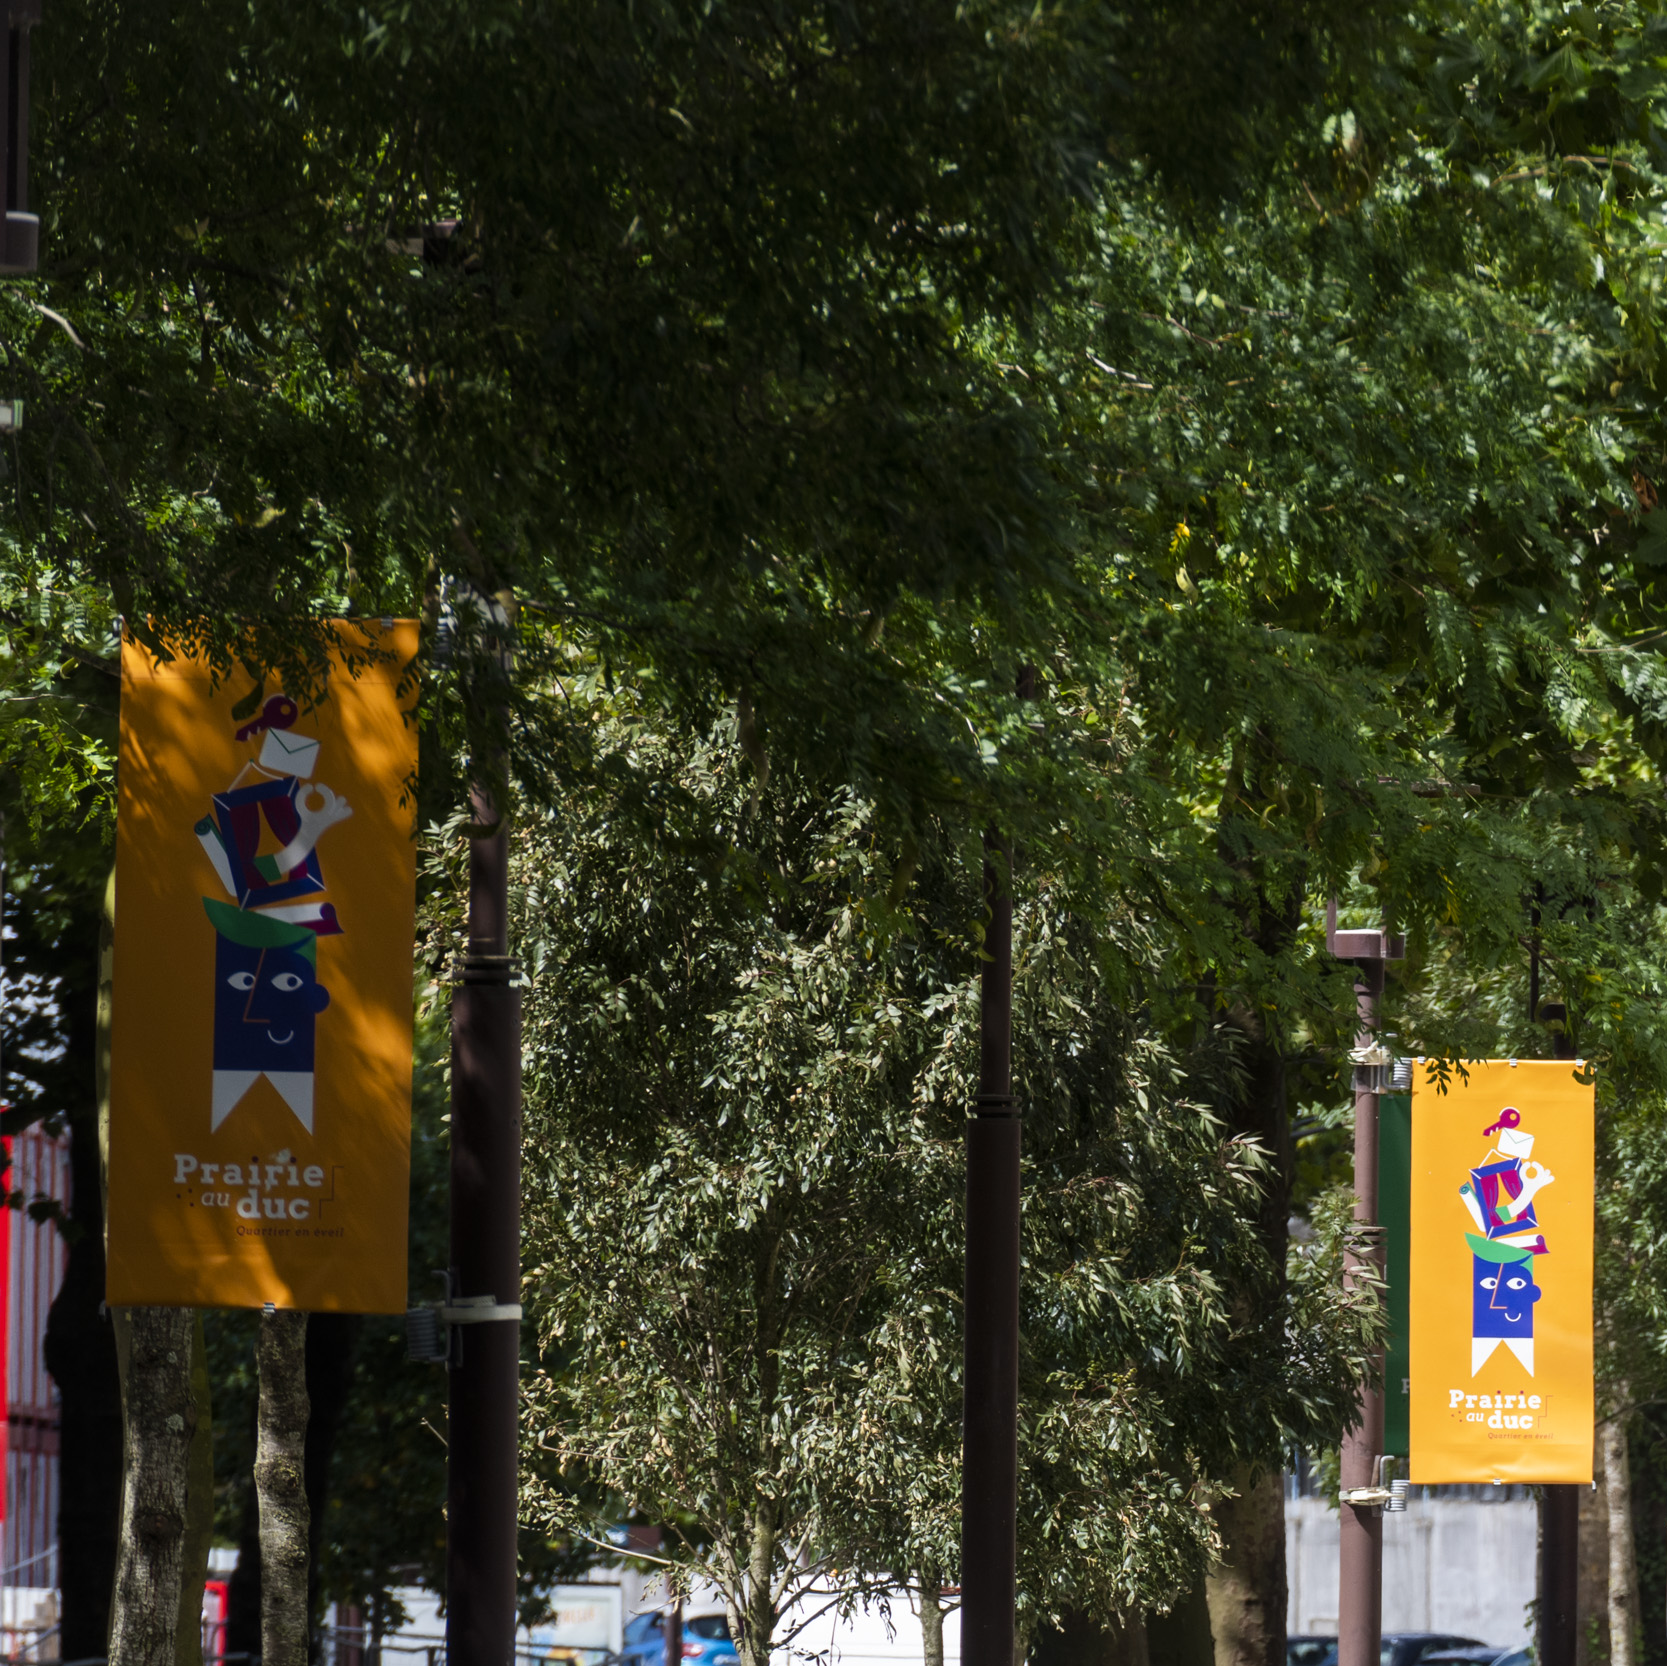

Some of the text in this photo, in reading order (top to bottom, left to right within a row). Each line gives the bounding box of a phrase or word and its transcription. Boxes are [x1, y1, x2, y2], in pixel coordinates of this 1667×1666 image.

[173, 1153, 325, 1187] Prairie
[201, 1188, 310, 1219] au duc
[236, 1225, 345, 1238] Quartier en éveil
[1449, 1389, 1541, 1409] Prairie
[1466, 1410, 1533, 1429] au duc
[1488, 1432, 1522, 1440] Quartier
